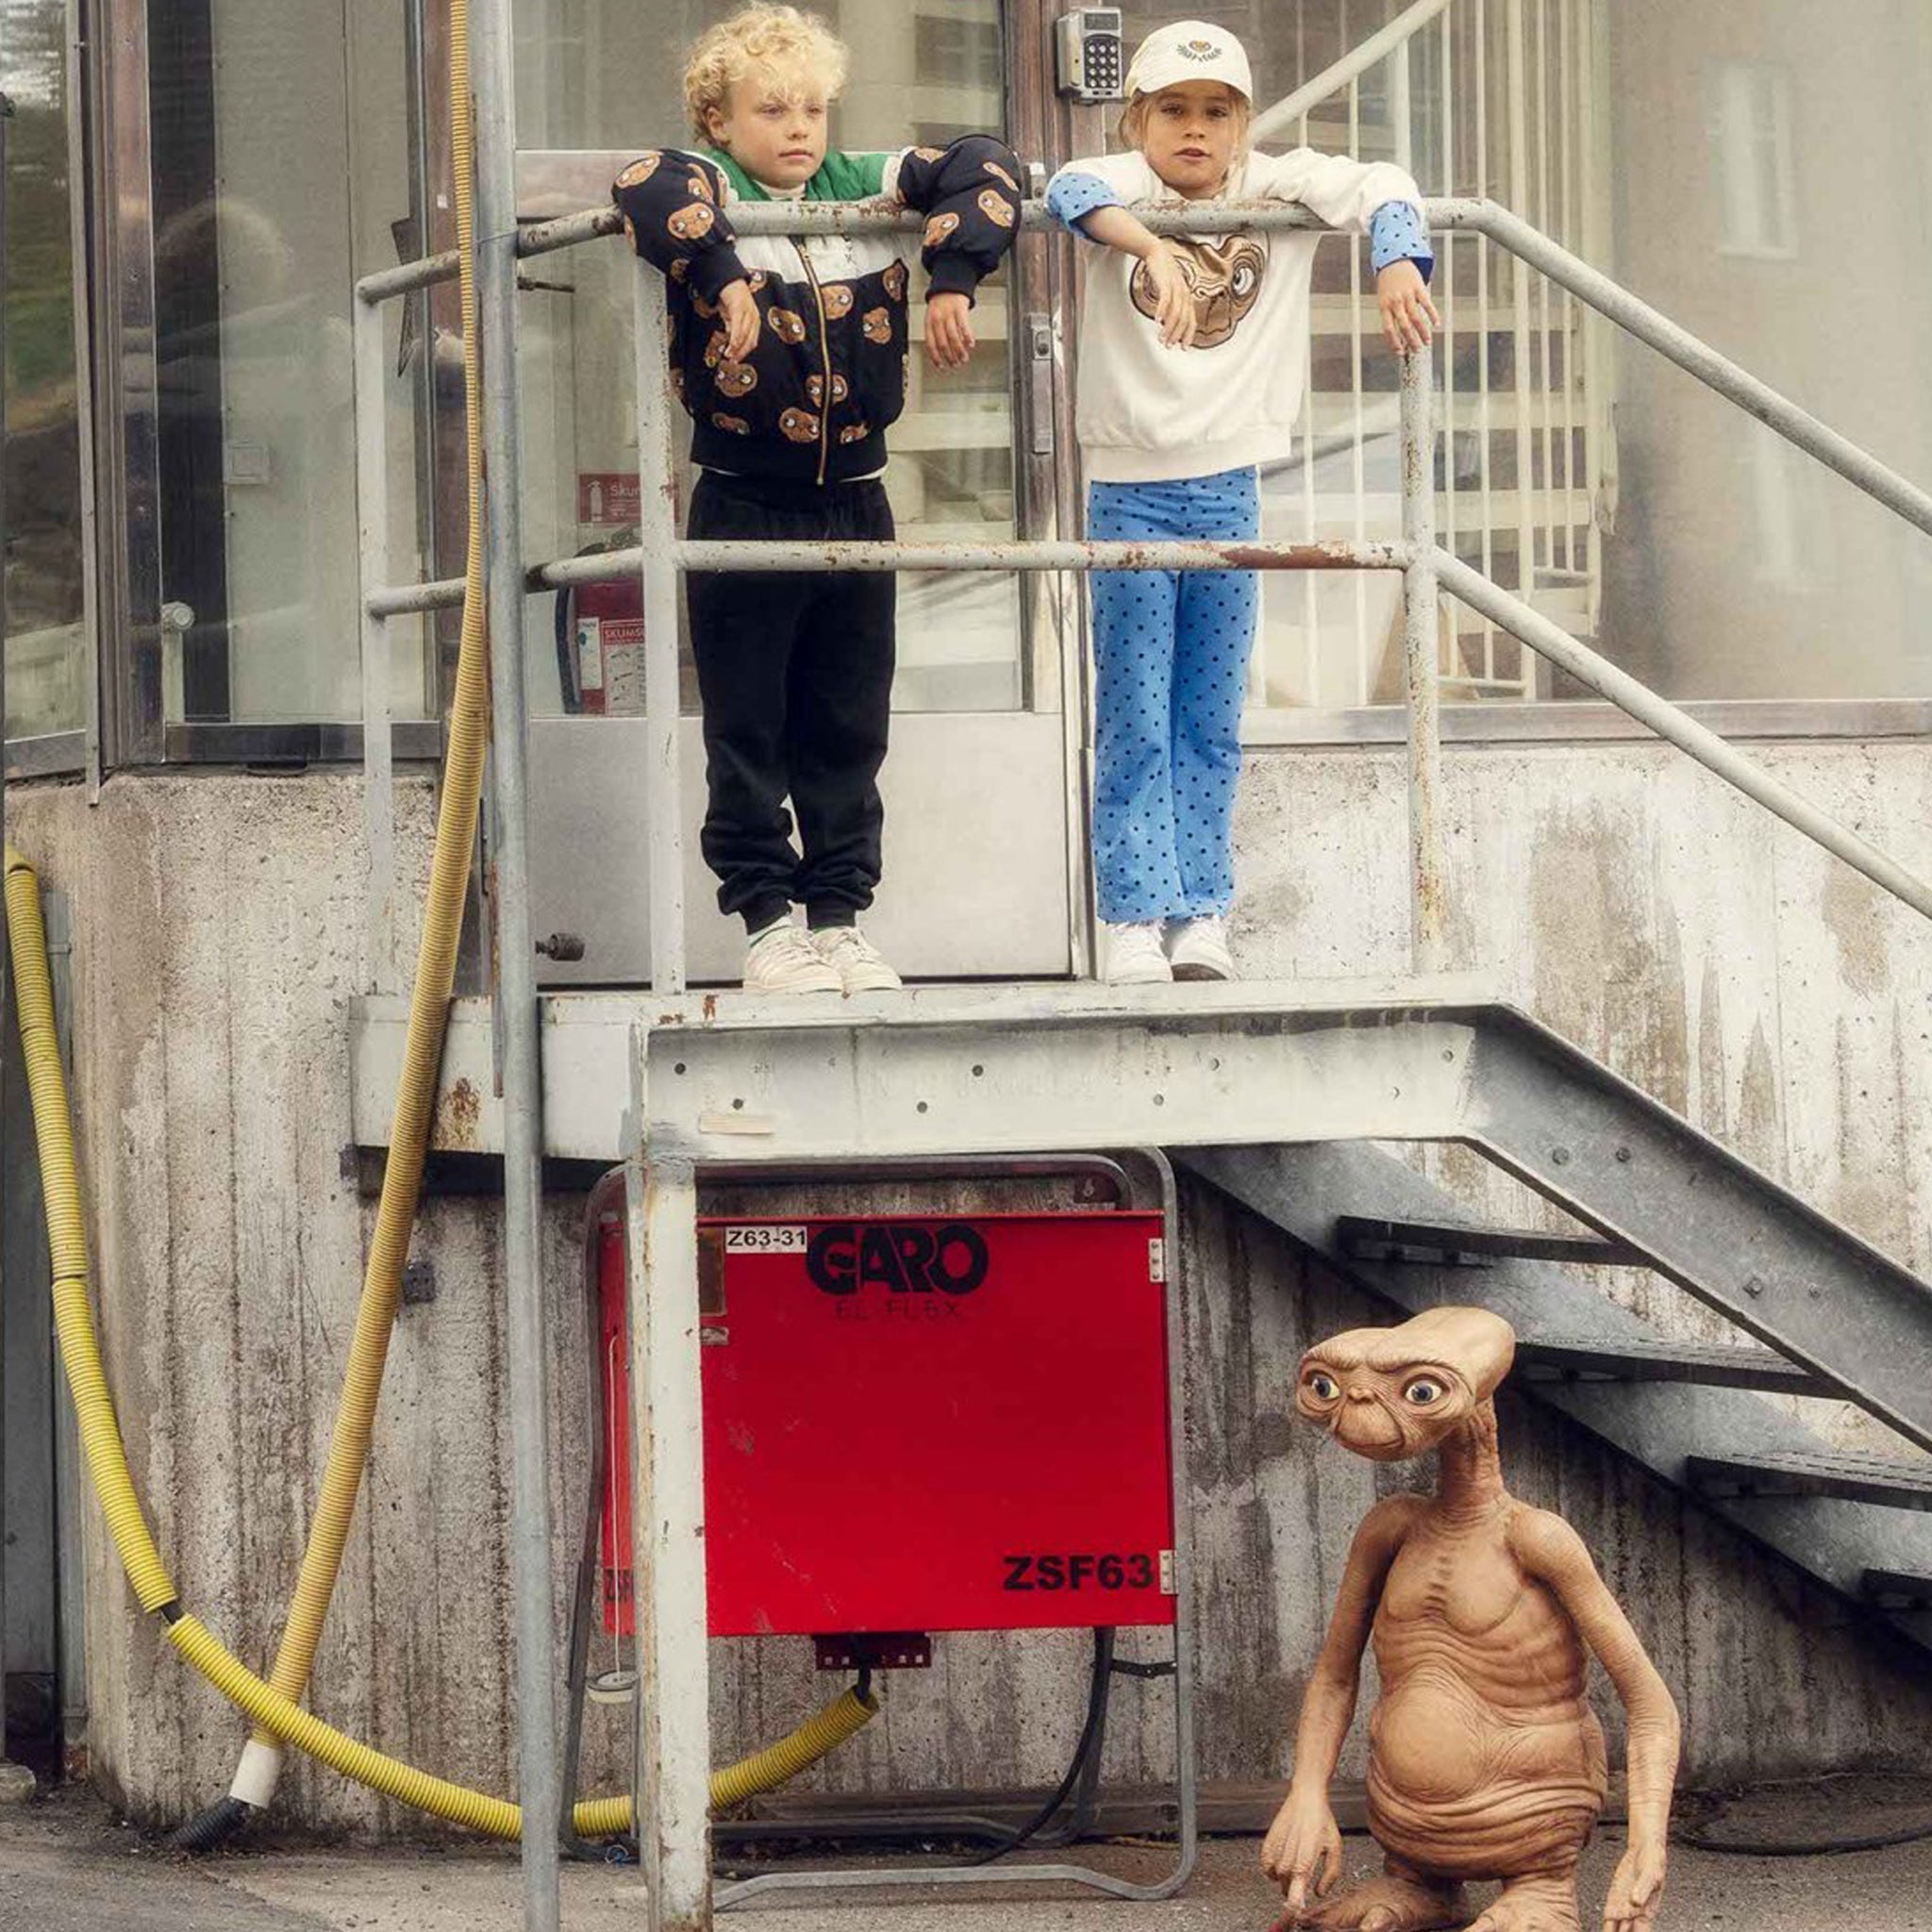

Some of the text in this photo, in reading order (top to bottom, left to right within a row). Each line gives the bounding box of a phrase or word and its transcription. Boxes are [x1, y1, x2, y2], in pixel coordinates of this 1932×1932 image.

[727, 1229, 806, 1246] Z63-31
[806, 1225, 989, 1295] GARO
[1003, 1553, 1154, 1591] ZSF63
